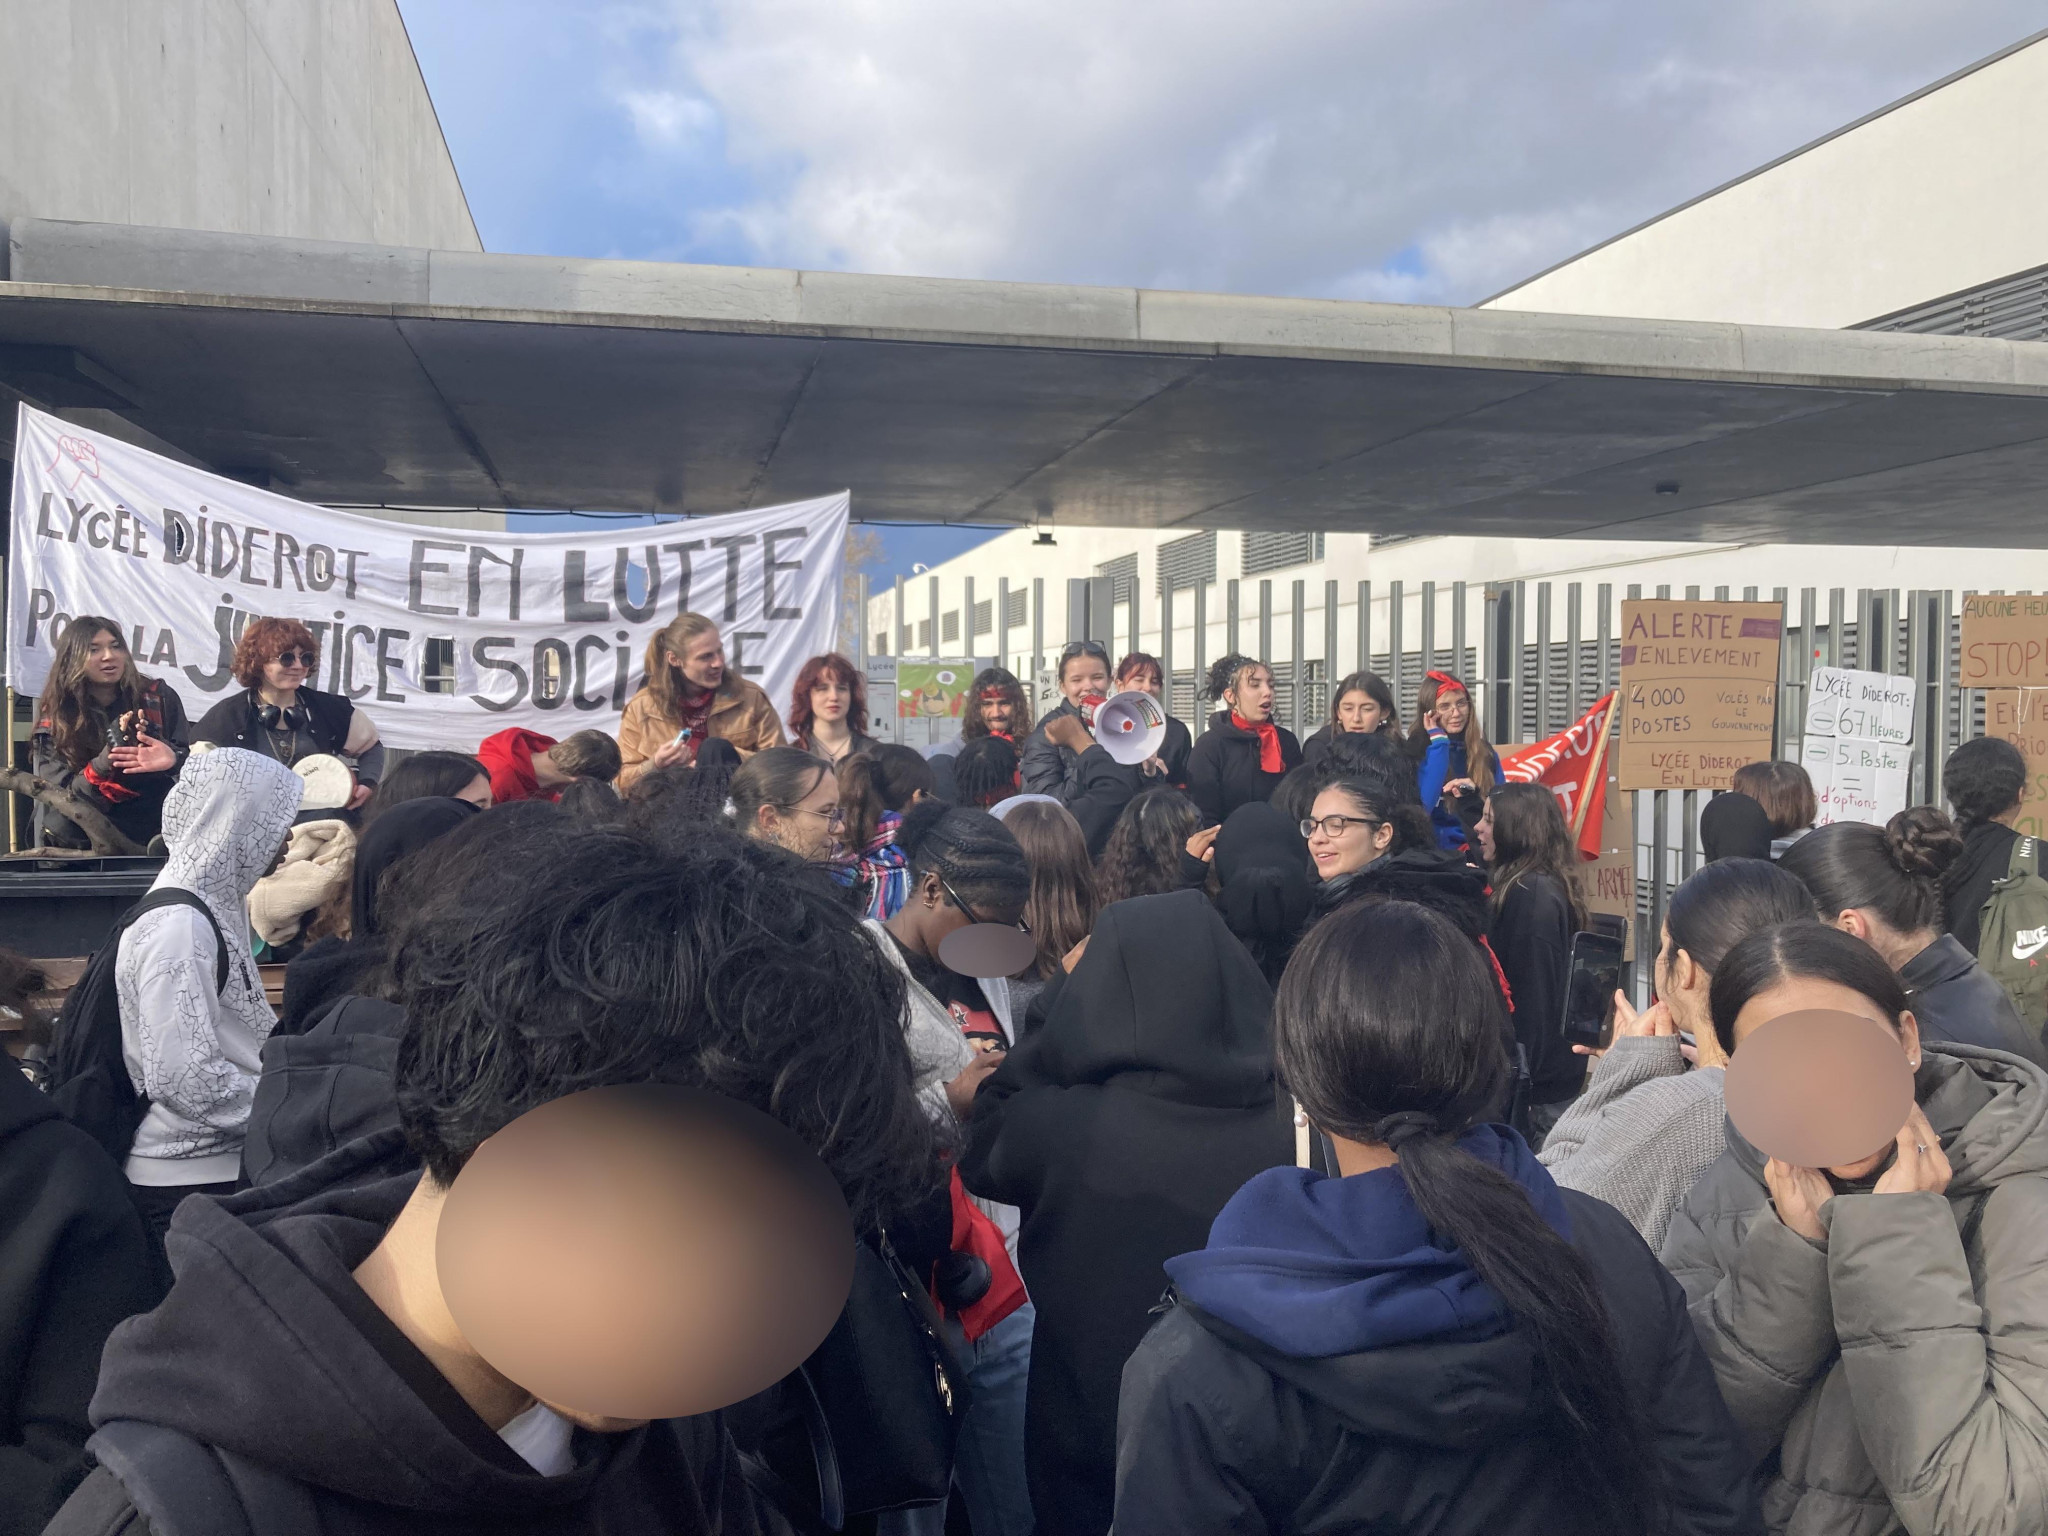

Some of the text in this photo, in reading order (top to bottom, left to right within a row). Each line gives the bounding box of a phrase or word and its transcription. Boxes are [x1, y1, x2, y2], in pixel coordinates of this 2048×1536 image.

[408, 540, 523, 621] EN
[563, 527, 808, 623] LUTTE
[1964, 599, 2018, 619] AUCUNE
[1628, 612, 1733, 640] ALERTE
[132, 625, 178, 668] LA
[1640, 646, 1761, 668] ENLEVEMENT
[1815, 672, 1852, 699] LYCÉE
[1716, 690, 1773, 706] VOLÉS PAR
[1736, 708, 1748, 717] LE
[1839, 707, 1866, 737] 67
[1632, 715, 1691, 734] POSTES
[1711, 717, 1773, 733] GOUVERNEMENT
[1651, 750, 1690, 769] LYCÉE
[1661, 768, 1735, 786] EN LUTTE
[1821, 785, 1878, 813] d'options
[2016, 925, 2048, 947] NIKE
